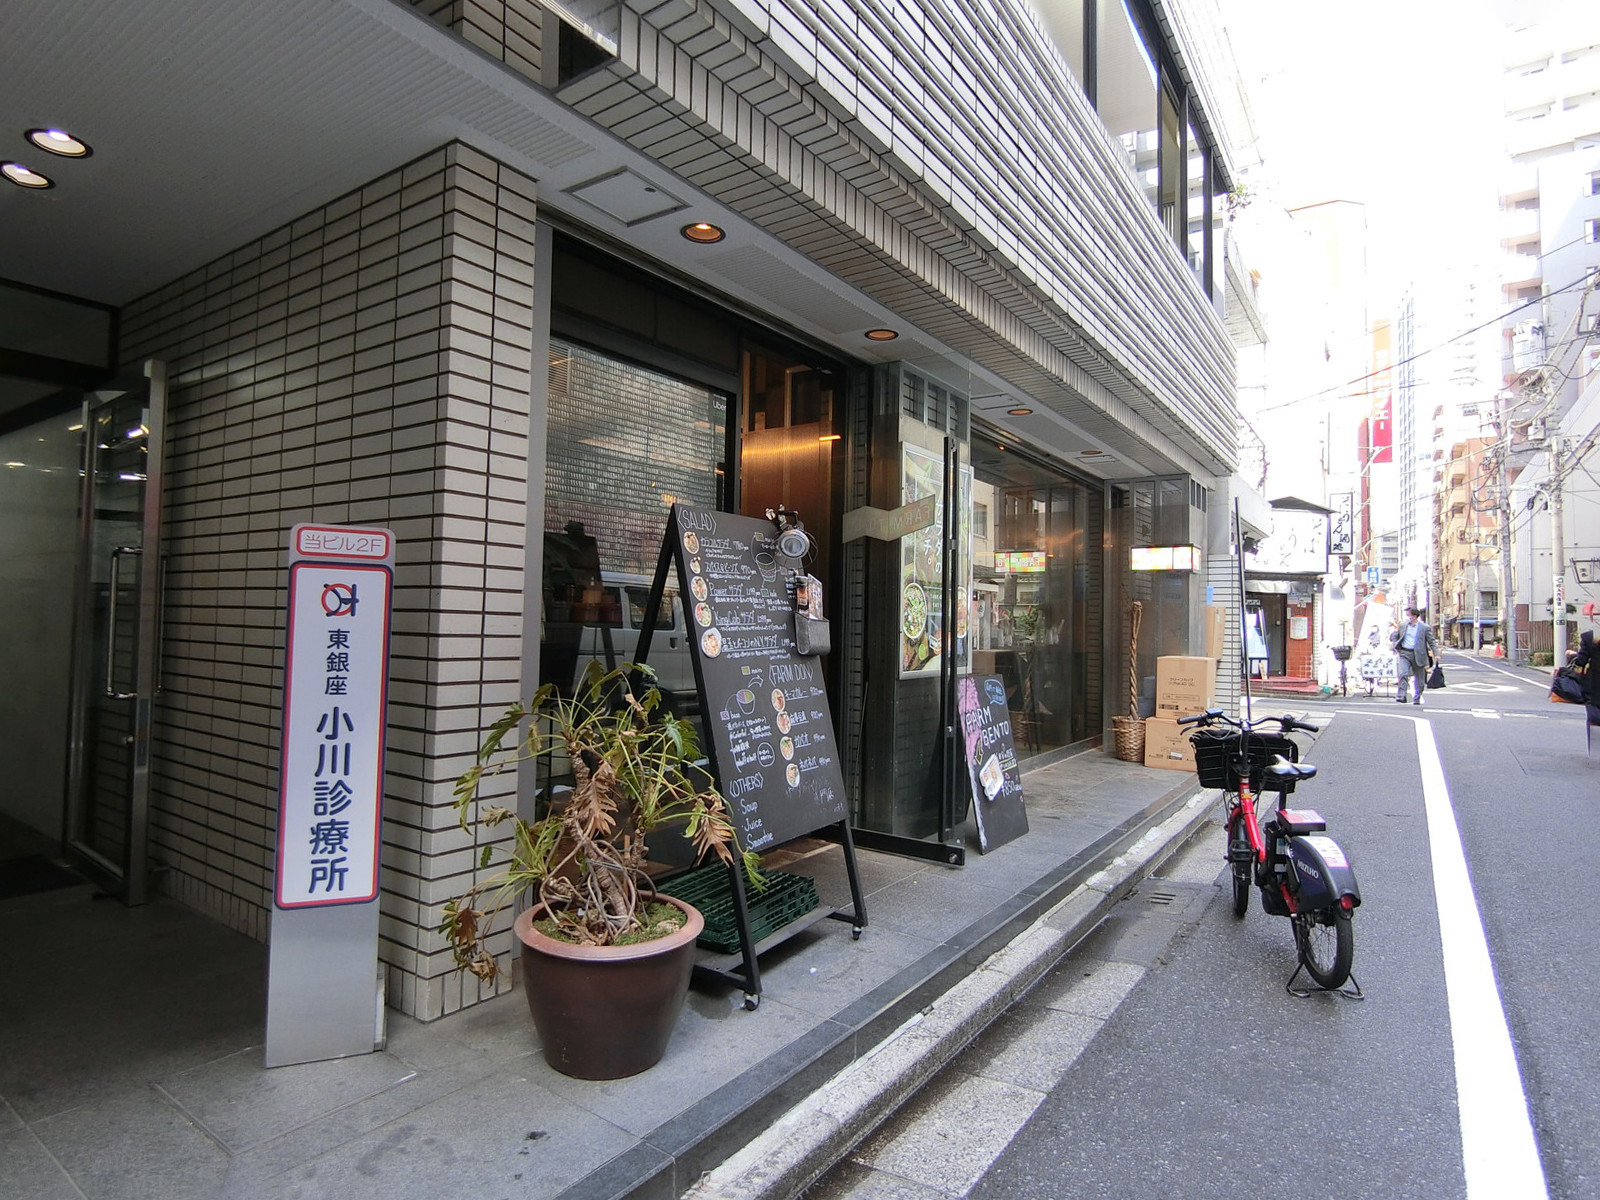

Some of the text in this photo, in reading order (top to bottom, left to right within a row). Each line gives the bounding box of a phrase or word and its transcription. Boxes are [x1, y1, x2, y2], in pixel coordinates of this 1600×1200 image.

[303, 533, 383, 554] 当ビル2F
[324, 628, 351, 697] 東銀座
[965, 705, 993, 734] FARM
[981, 720, 1010, 746] BENTO
[308, 706, 355, 895] 小川診療所
[740, 799, 759, 814] Soup
[743, 818, 763, 832] Juice
[747, 830, 774, 850] Smoothie
[1296, 859, 1319, 879] MIZUHO
